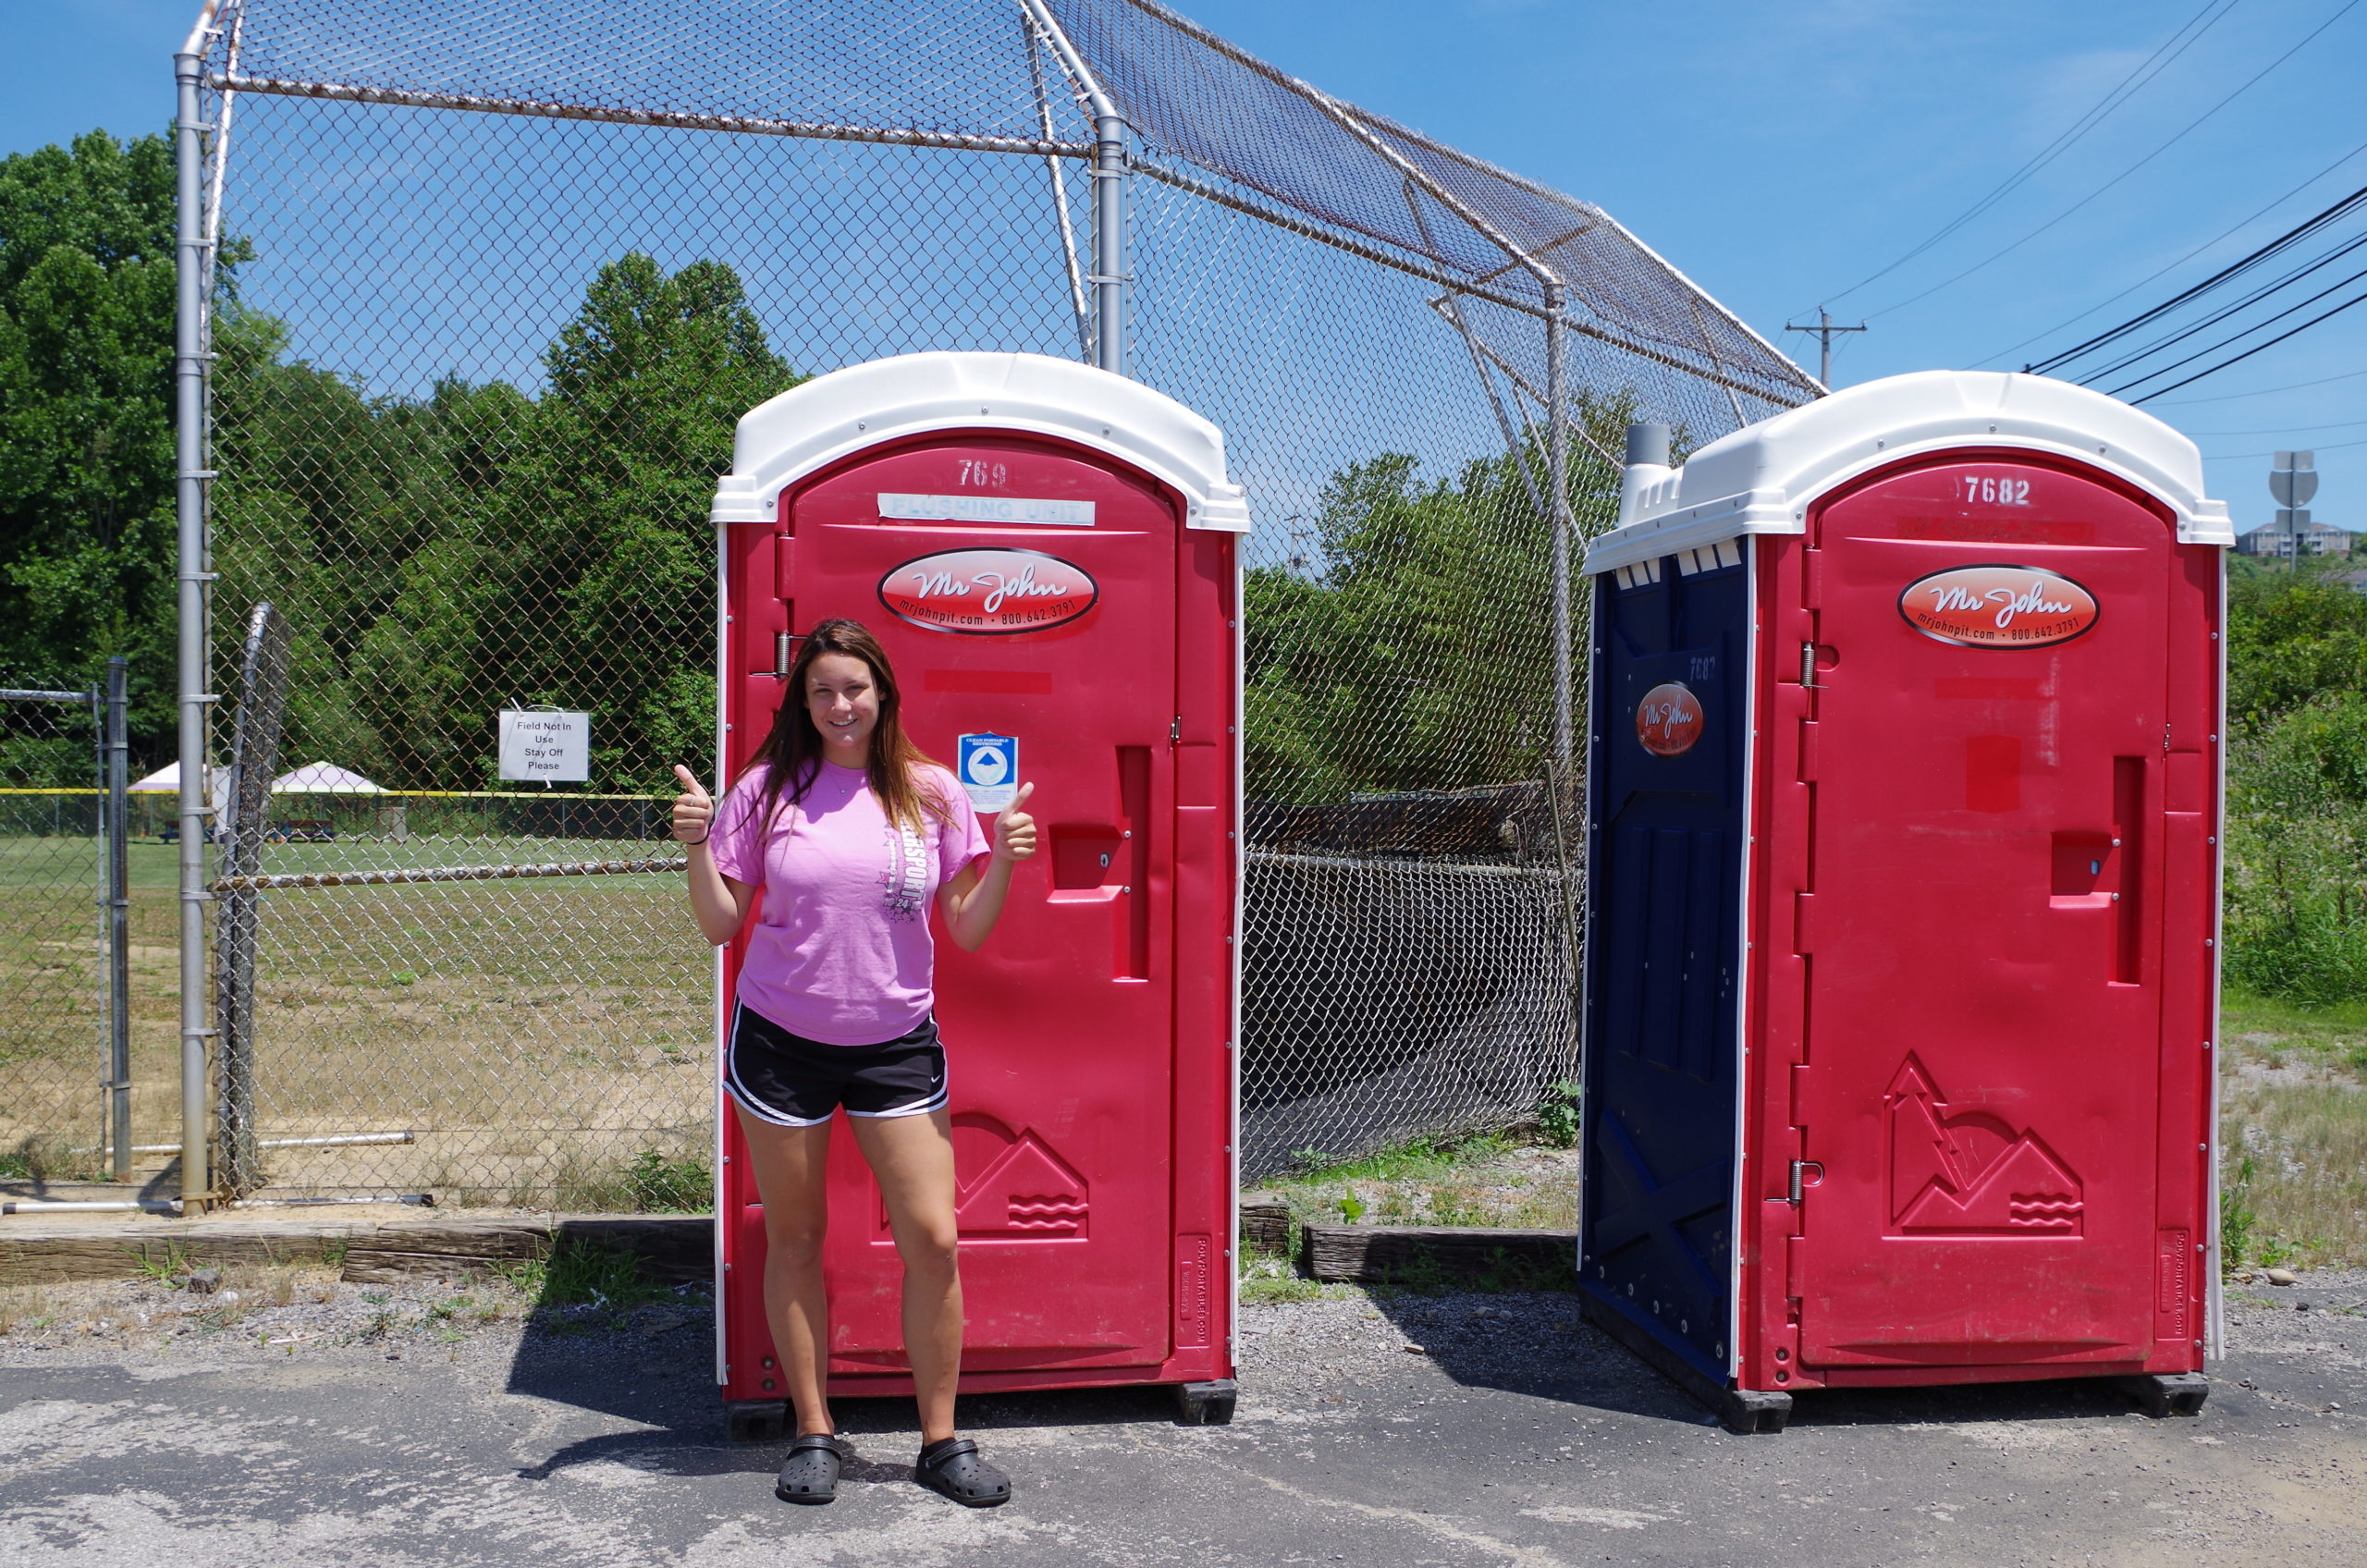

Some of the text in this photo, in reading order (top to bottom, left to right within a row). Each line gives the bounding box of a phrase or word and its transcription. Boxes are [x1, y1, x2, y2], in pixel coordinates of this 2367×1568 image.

[1965, 476, 2030, 505] 7682
[892, 496, 1081, 521] FLUSHING UNIT
[913, 563, 1068, 614] Mr John
[899, 599, 1076, 626] mrjohnpit.com 800.642.3791
[1930, 581, 2073, 629] Mr John
[1917, 612, 2079, 641] mrjohnpit.com 800.642.3791
[517, 722, 571, 731] Field Not In
[1644, 703, 1661, 727] Mr
[1660, 693, 1693, 740] John
[535, 735, 554, 743] Use
[524, 748, 564, 758] Stay Off
[528, 761, 560, 770] Please
